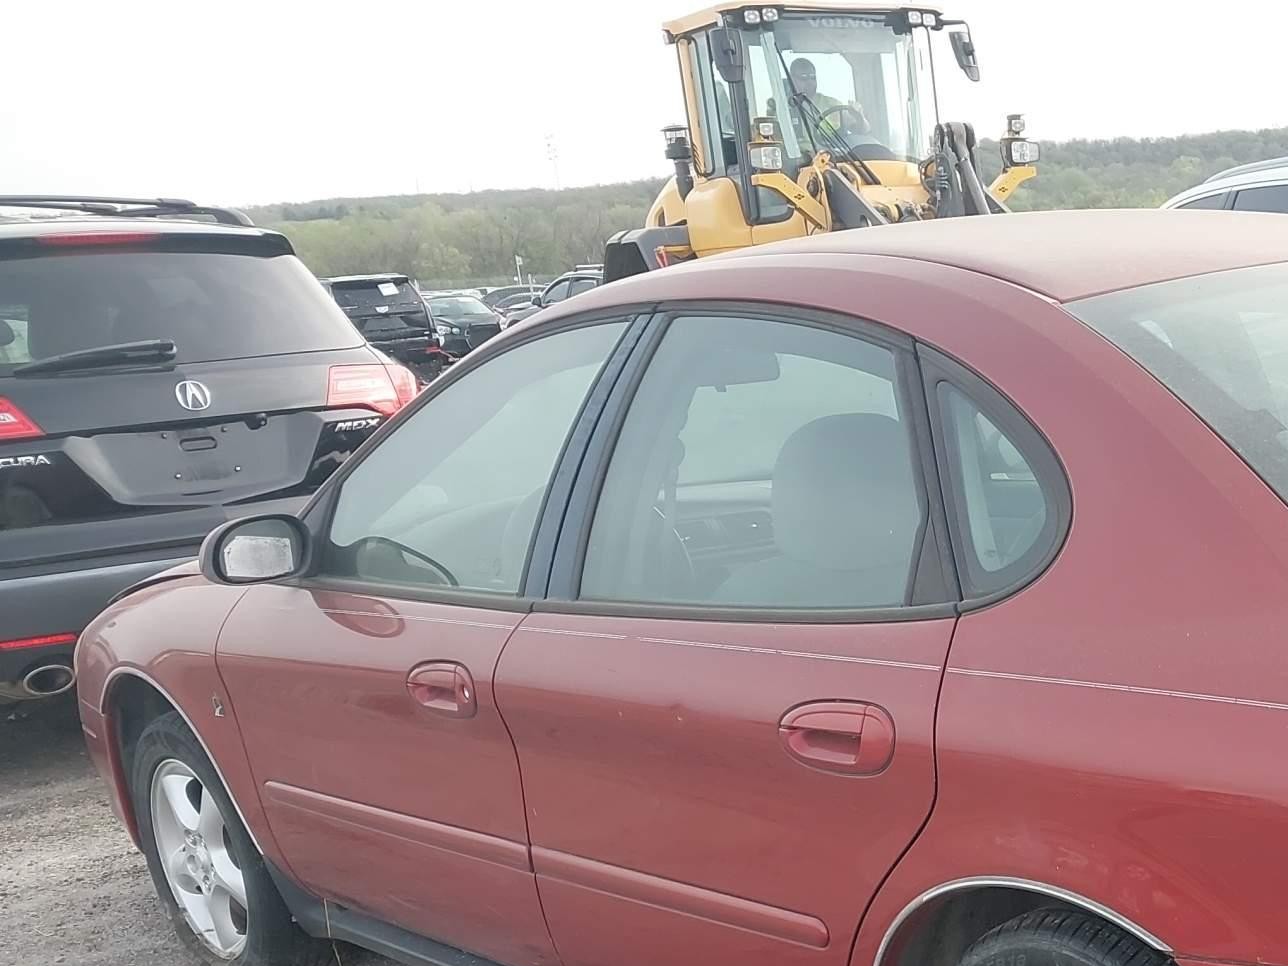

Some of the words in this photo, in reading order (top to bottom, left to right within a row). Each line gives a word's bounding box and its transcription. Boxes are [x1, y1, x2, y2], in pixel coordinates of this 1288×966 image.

[808, 17, 875, 29] VOLVO
[334, 418, 380, 432] MDX
[0, 455, 51, 469] CURA
